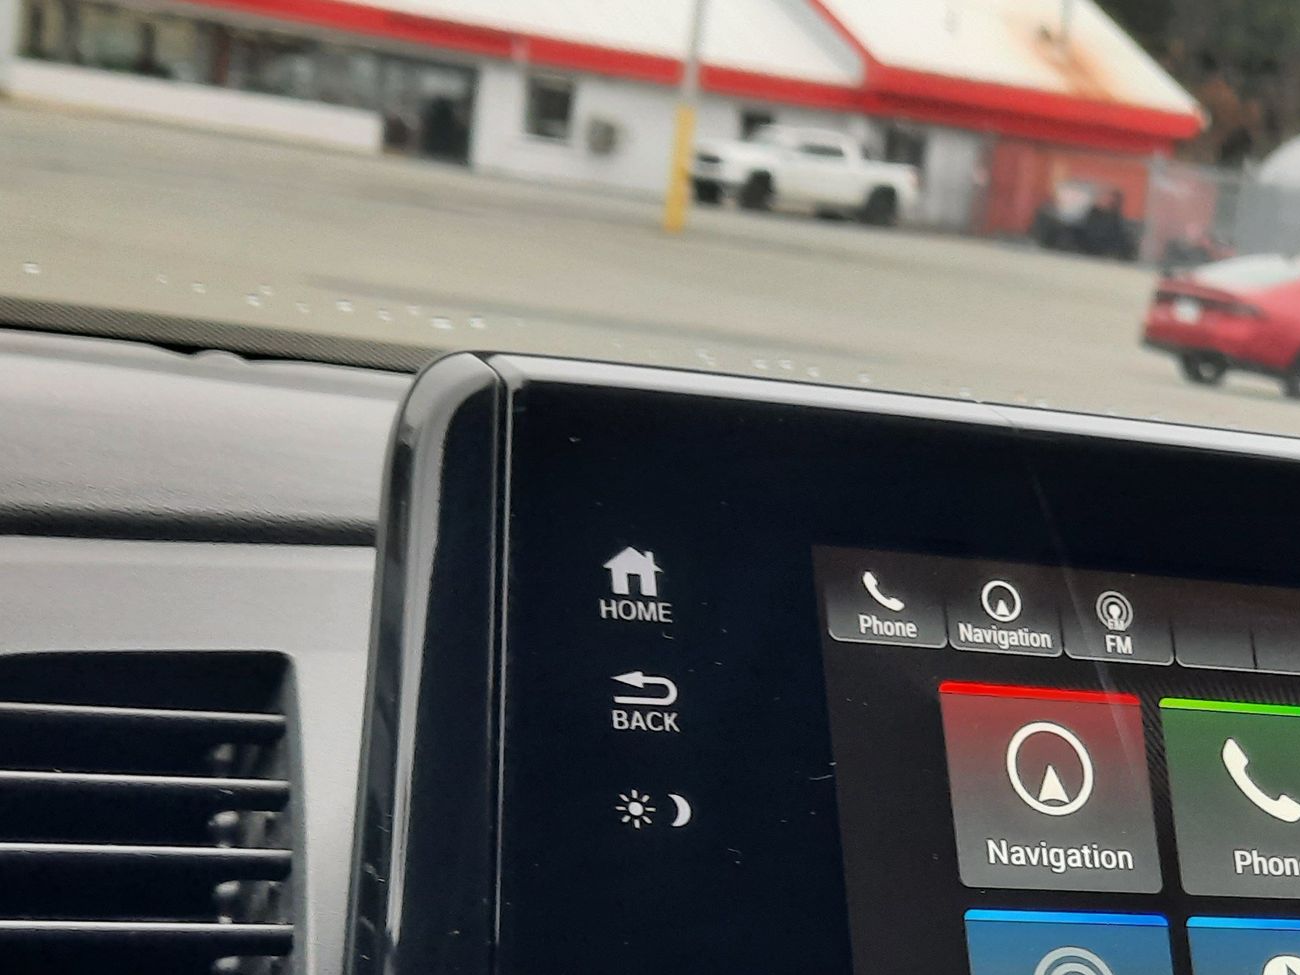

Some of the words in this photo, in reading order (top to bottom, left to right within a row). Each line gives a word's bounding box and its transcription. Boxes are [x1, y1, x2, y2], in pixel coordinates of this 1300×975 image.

[599, 599, 673, 623] HOME
[858, 614, 918, 638] Phone
[958, 622, 1052, 650] Navigation
[1105, 634, 1133, 655] FM
[612, 709, 680, 733] BACK
[987, 839, 1134, 873] Navigation
